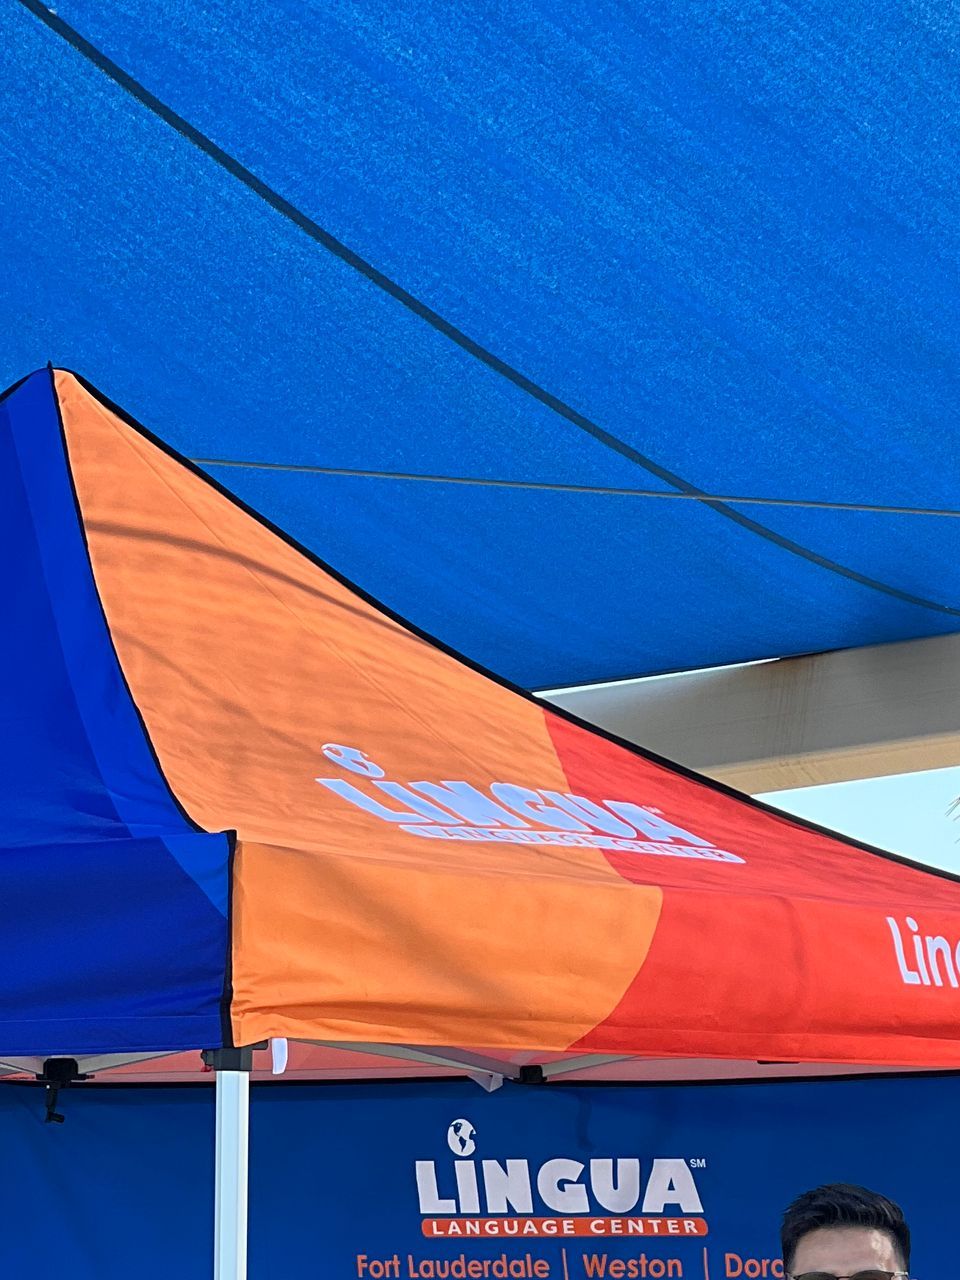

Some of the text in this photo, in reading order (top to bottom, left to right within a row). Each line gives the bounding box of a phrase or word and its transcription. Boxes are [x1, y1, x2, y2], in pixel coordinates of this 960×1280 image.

[315, 778, 717, 847] LINGUA
[415, 1158, 706, 1215] LINGUA SM
[432, 1219, 699, 1236] LANGUAGE CENTER
[357, 1253, 784, 1279] Fort Lauderdale Weston Dora
